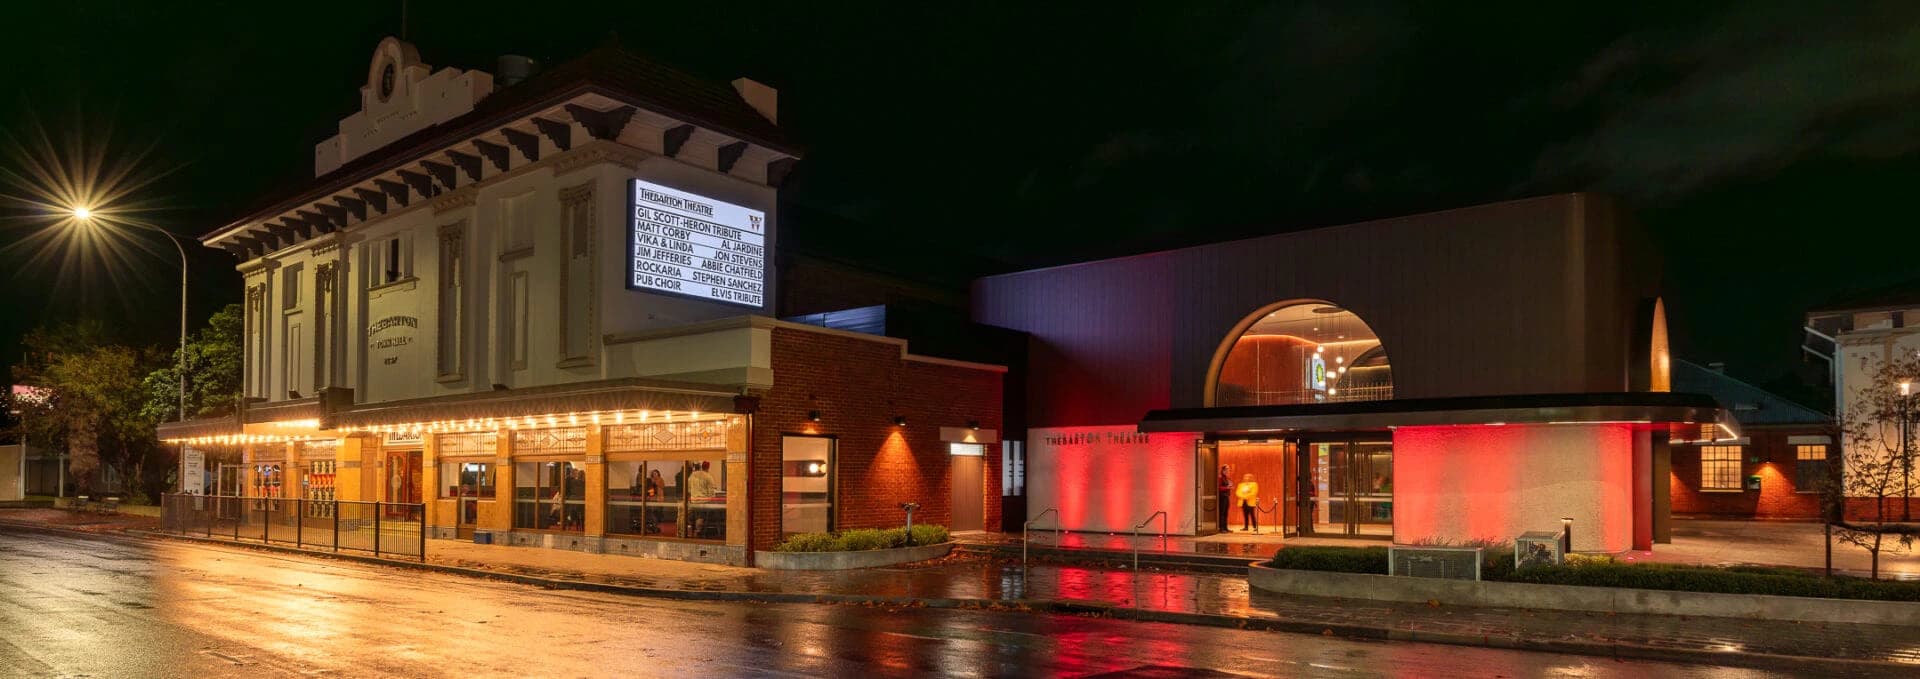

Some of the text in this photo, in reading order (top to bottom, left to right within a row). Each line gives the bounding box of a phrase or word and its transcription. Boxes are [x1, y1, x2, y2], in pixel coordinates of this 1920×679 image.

[637, 222, 691, 241] MATT CORBY
[638, 208, 742, 241] GIL SCOTT-HERON TRIBUTE
[637, 232, 694, 254] VIKA & LINDA
[721, 240, 763, 257] AL JARDINE
[636, 246, 692, 266] JIM JEFFERIES
[714, 250, 763, 269] JON STEVENS
[636, 260, 682, 278] ROCKARIA
[701, 260, 763, 280] ABBIE CHATFIELD
[636, 274, 682, 291] PUB CHOIR
[692, 271, 762, 293] STEPHEN SANCHEZ
[712, 288, 762, 304] ELVIS TRIBUTE
